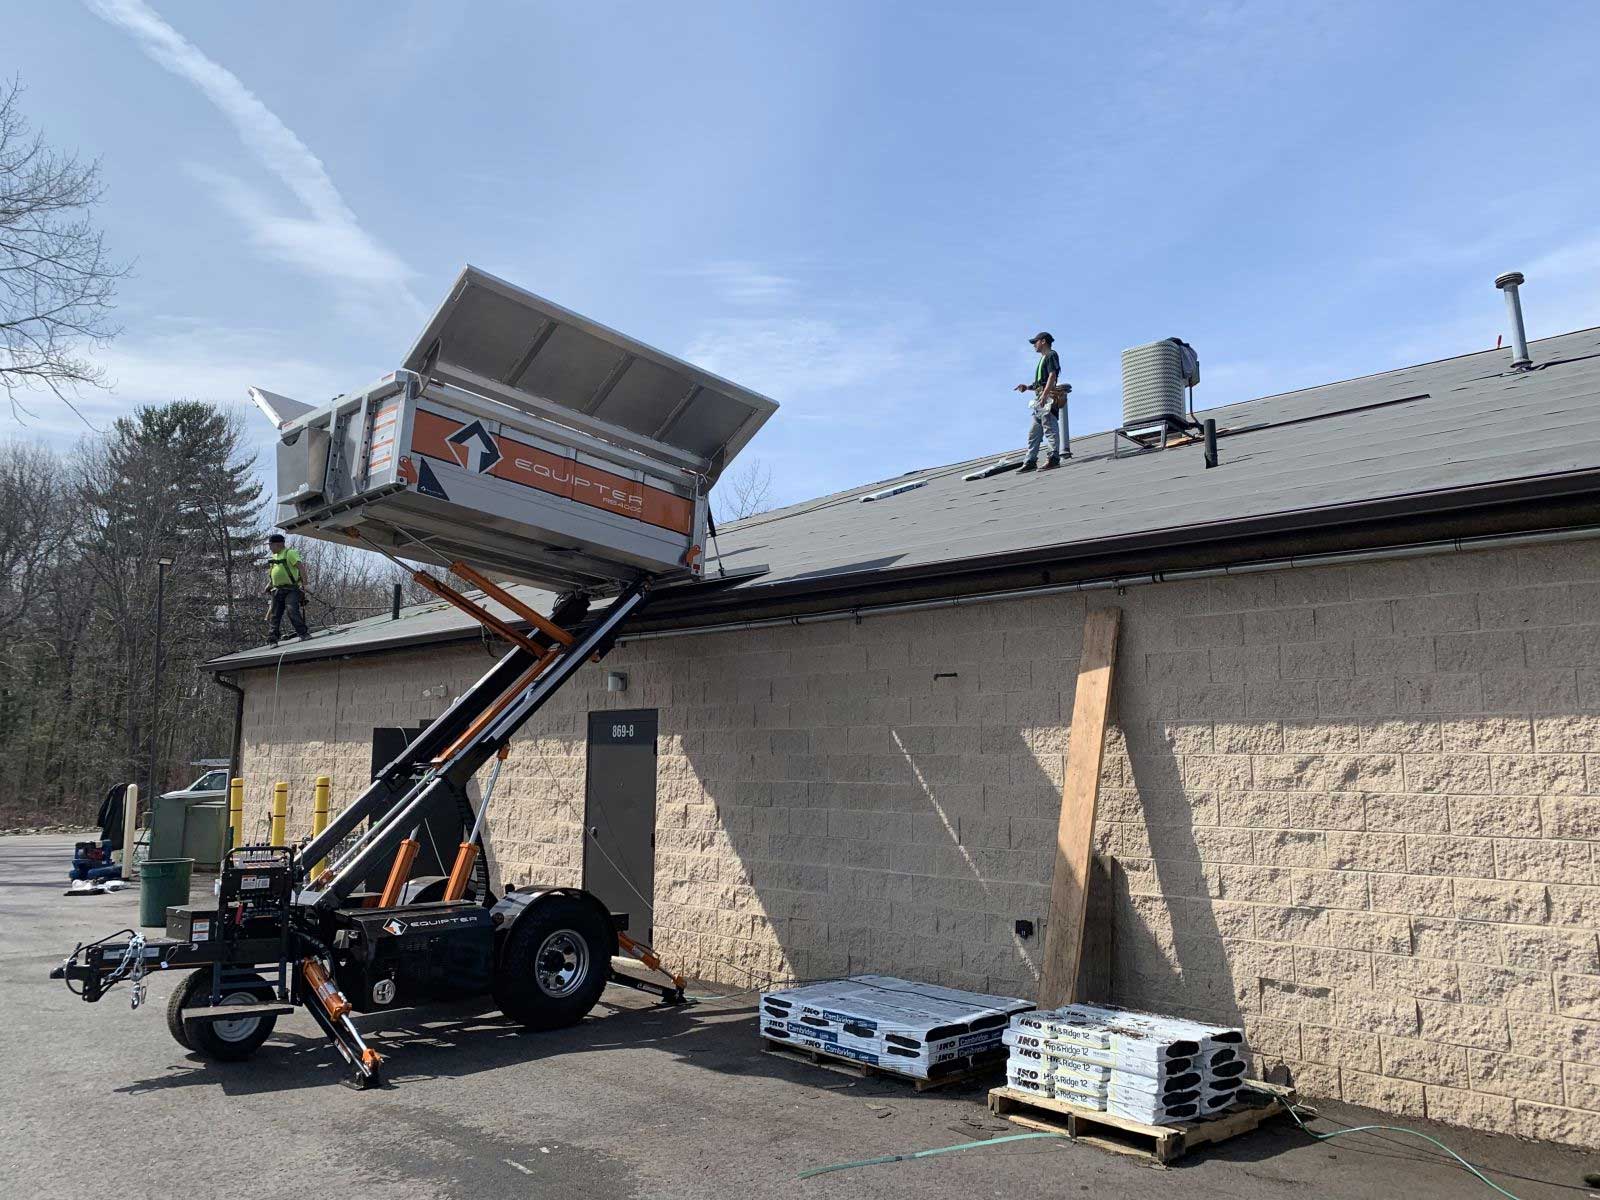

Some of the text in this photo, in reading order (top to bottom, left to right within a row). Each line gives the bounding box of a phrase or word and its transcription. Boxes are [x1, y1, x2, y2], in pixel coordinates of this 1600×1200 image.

[514, 458, 643, 506] EQUIPTER
[612, 724, 634, 738] 869-8
[410, 916, 477, 927] EQUIPTER
[803, 1006, 820, 1016] IKO
[769, 1019, 785, 1028] IKO
[1020, 1018, 1042, 1030] IKO
[1063, 1028, 1081, 1040] Ridge
[1082, 1032, 1090, 1040] 12
[805, 1039, 822, 1049] IKO
[938, 1040, 956, 1051] IKO
[1018, 1035, 1040, 1047] IKO
[1062, 1045, 1081, 1057] Ridge
[1082, 1048, 1089, 1056] 12
[937, 1052, 955, 1062] IKO
[1019, 1048, 1042, 1060] IKO
[1083, 1063, 1091, 1071] 12
[1017, 1068, 1039, 1080] IKO
[1060, 1076, 1079, 1088] Ridge
[1080, 1080, 1088, 1088] 12
[1017, 1078, 1040, 1091] IKO
[1080, 1095, 1088, 1103] 12
